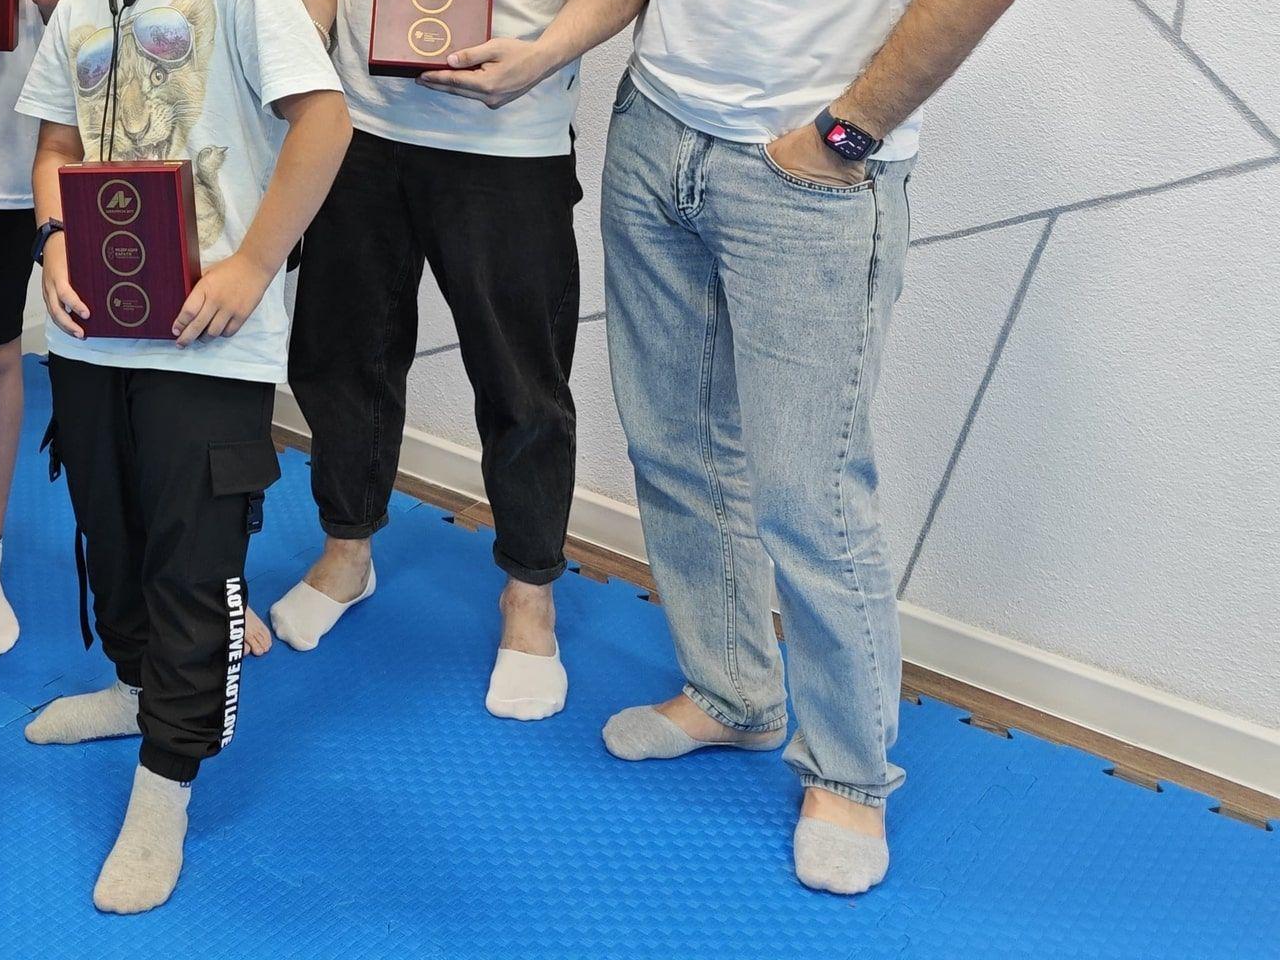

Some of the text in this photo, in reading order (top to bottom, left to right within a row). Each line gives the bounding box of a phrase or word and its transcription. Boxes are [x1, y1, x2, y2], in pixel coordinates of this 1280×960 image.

[228, 619, 245, 662] LOVE
[225, 662, 241, 706] LOVE
[221, 706, 236, 748] LOVE
